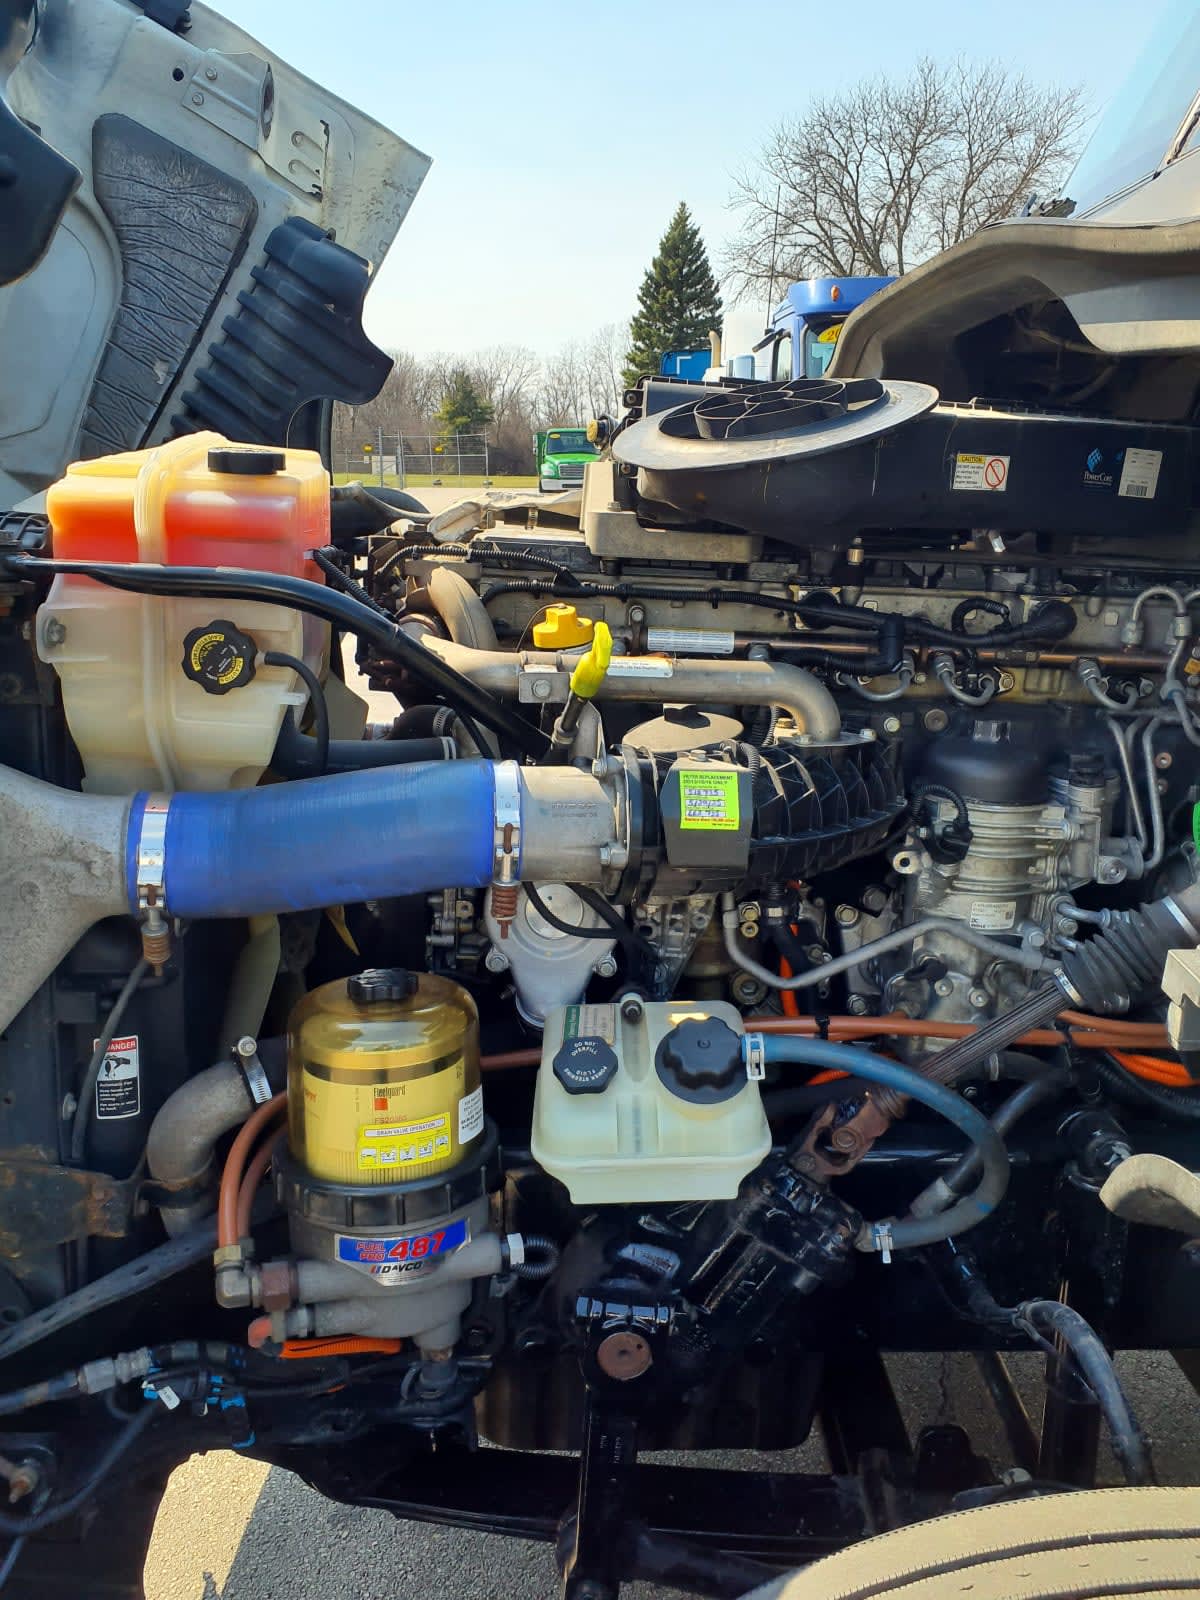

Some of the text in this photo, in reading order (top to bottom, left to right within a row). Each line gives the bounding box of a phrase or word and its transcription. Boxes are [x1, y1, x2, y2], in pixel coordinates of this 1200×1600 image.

[107, 1041, 136, 1051] ANGER
[571, 1046, 599, 1056] OVERFILL
[564, 1065, 608, 1082] POWER STEERING
[376, 1121, 436, 1137] DRAIN VALVE OPERATION
[356, 1231, 446, 1260] FUEL 487
[359, 1251, 386, 1260] PRO
[381, 1261, 422, 1274] DAVCO
